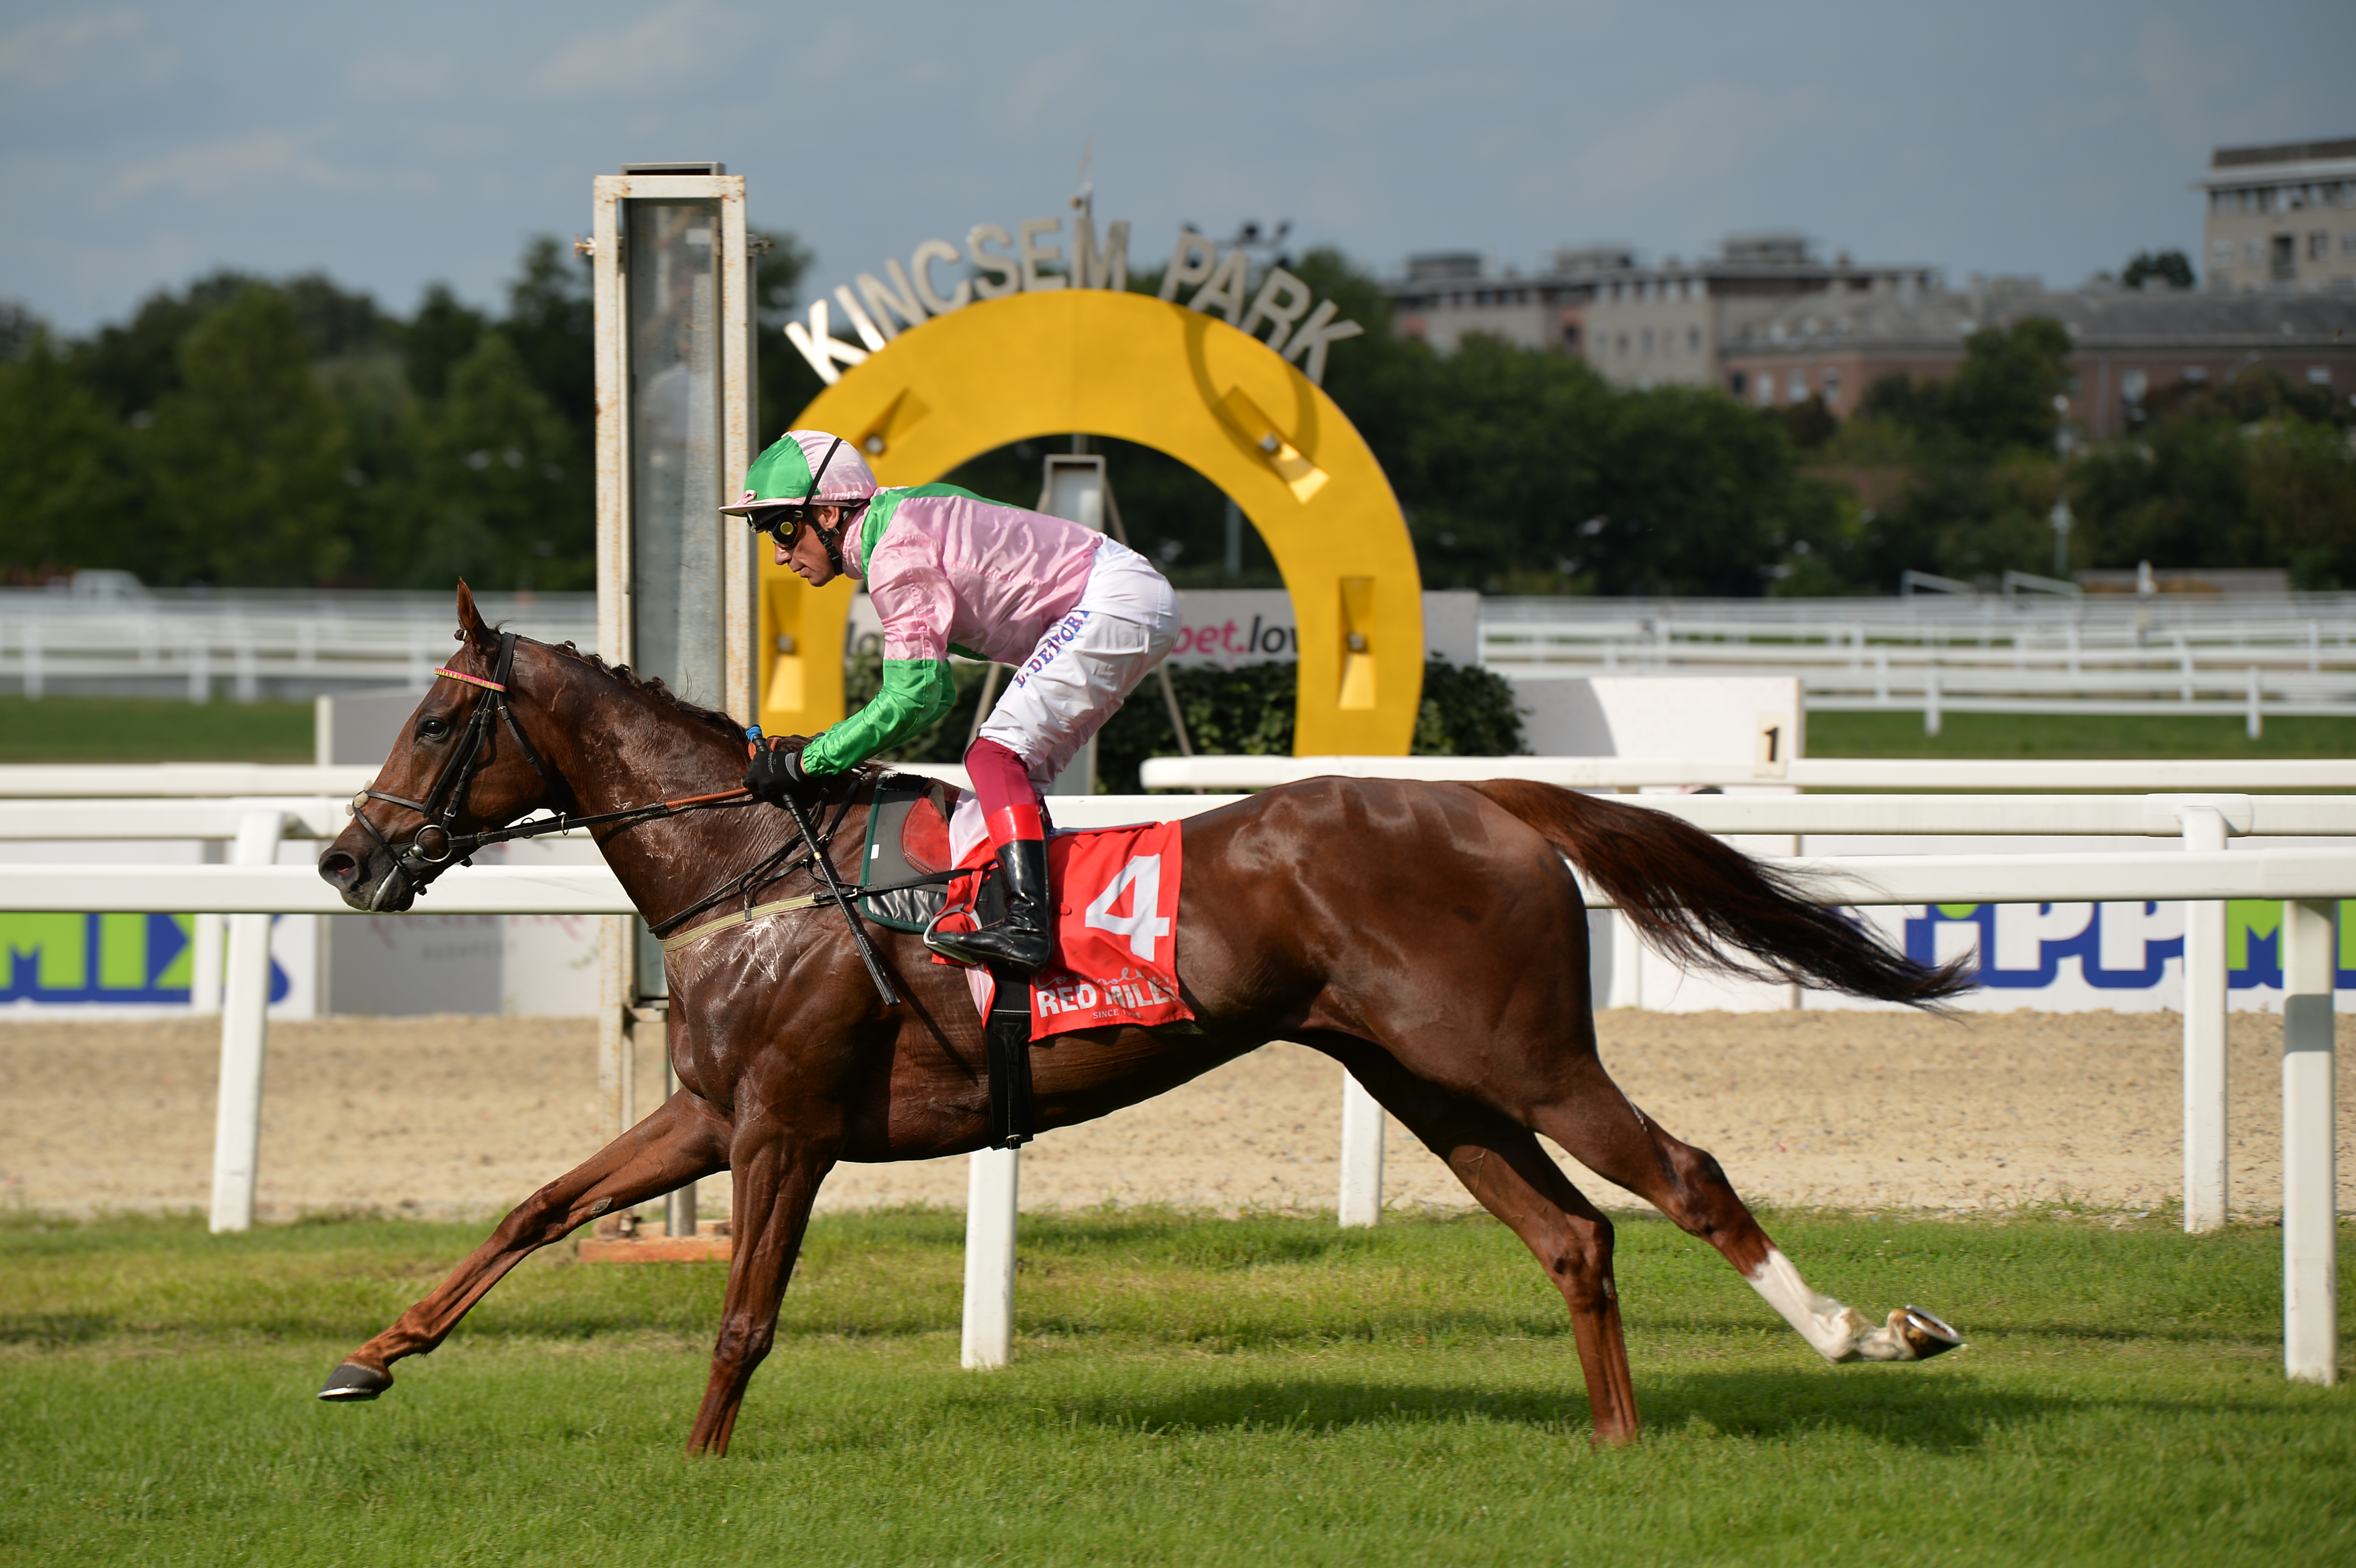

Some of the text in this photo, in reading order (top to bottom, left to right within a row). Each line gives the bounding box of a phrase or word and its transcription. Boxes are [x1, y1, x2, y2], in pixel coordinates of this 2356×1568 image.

[784, 216, 1365, 385] KINCSEM PARK
[1764, 727, 1780, 762] 1
[1085, 853, 1170, 962] 4
[1036, 983, 1097, 1018] RED
[1093, 1008, 1120, 1019] SINCE
